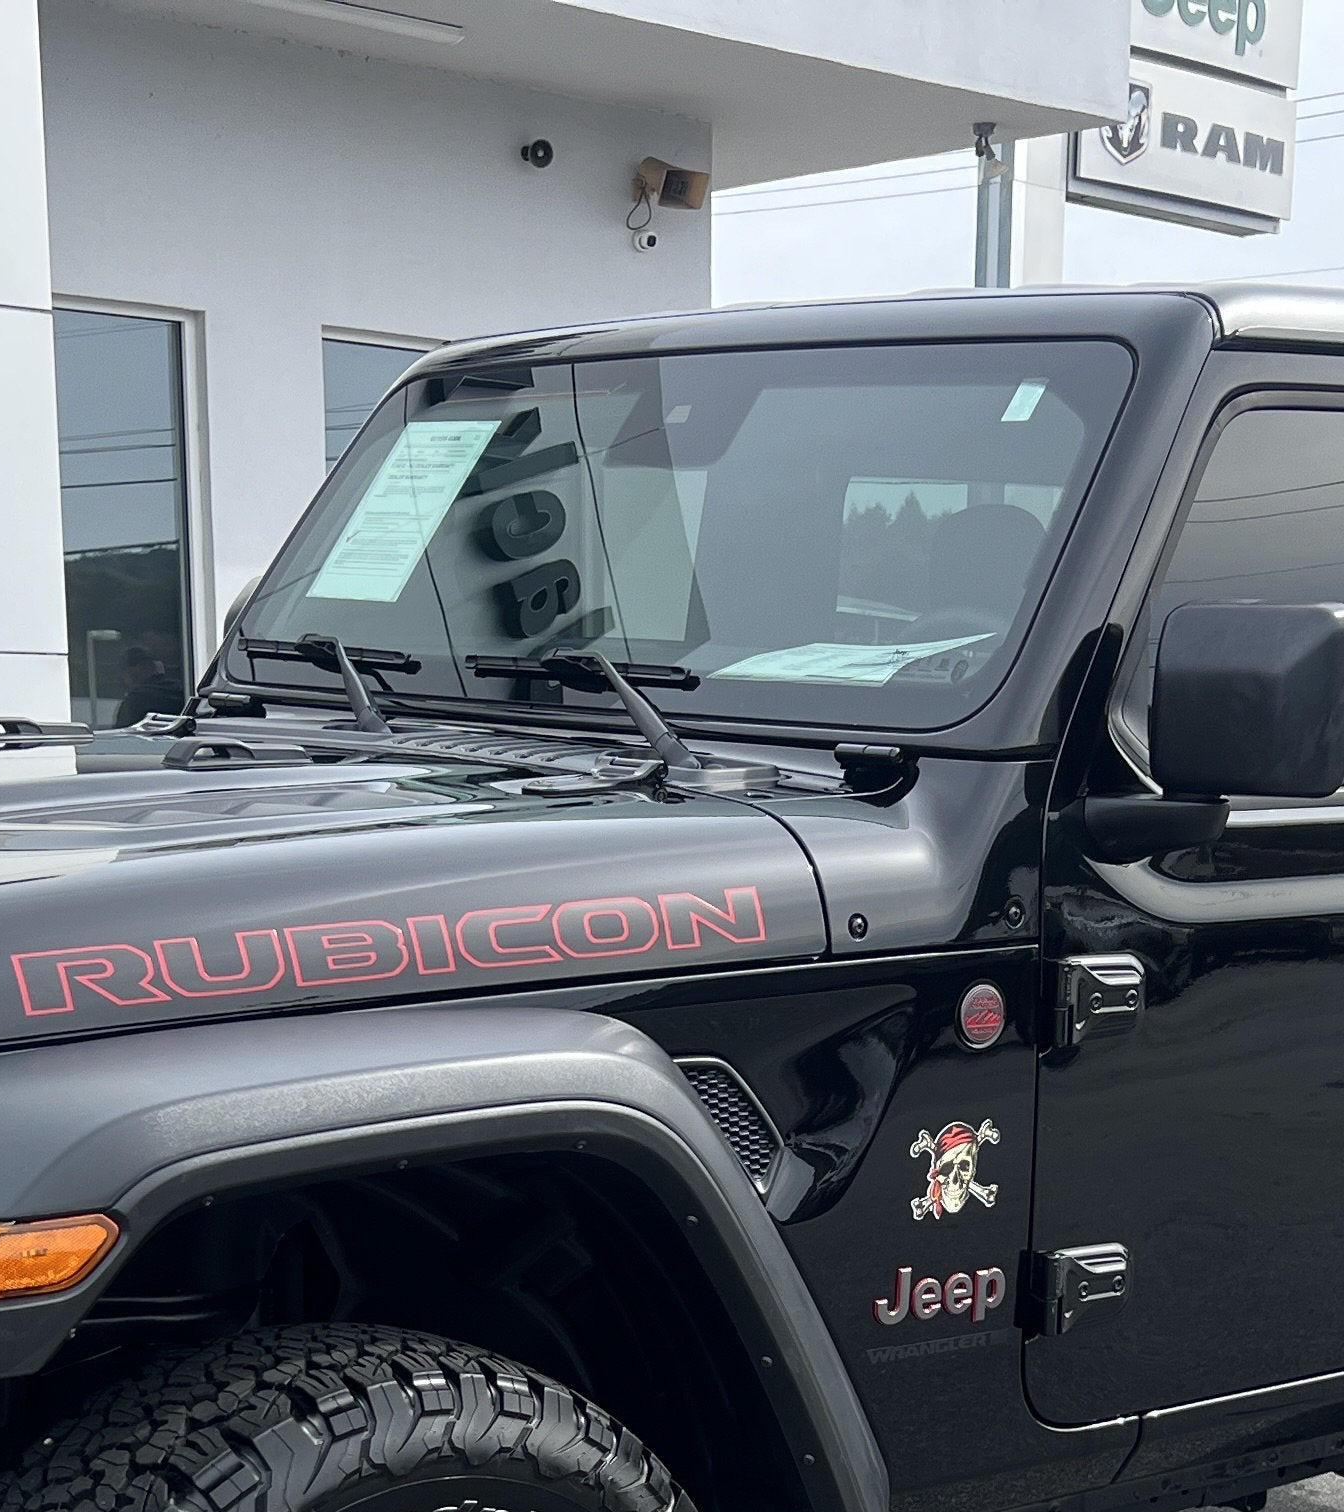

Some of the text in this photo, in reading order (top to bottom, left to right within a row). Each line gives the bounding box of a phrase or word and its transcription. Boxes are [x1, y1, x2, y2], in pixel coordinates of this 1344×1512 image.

[1142, 0, 1266, 56] eep
[1160, 111, 1285, 176] RAM
[10, 885, 767, 1017] RUBICON
[872, 1265, 1006, 1326] Jeep
[866, 1332, 992, 1364] WRANGLER
